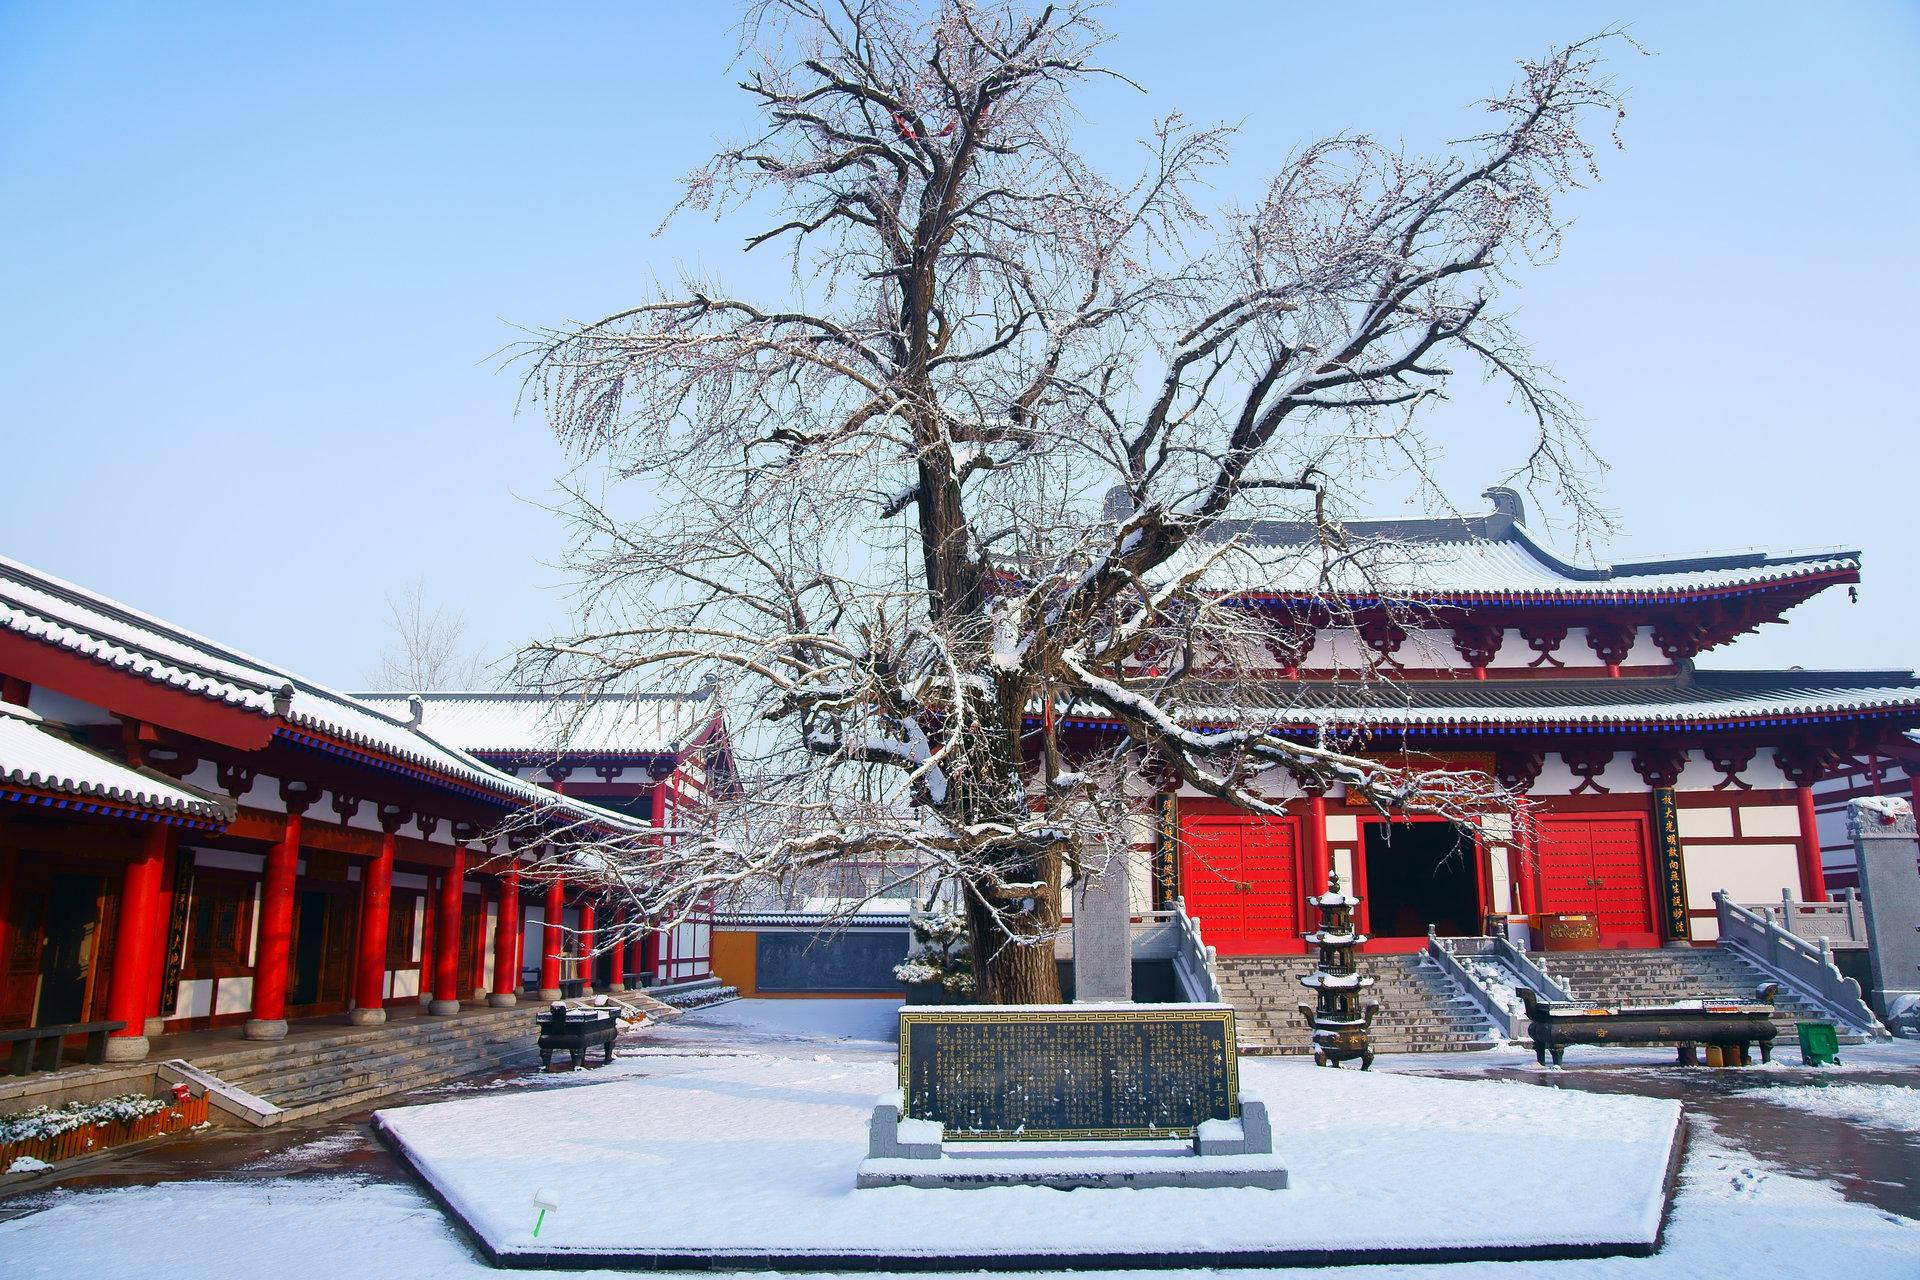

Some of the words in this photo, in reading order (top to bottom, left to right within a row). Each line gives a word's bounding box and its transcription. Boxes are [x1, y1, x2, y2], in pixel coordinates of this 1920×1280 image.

[1210, 1038, 1226, 1107] 银杏树王记
